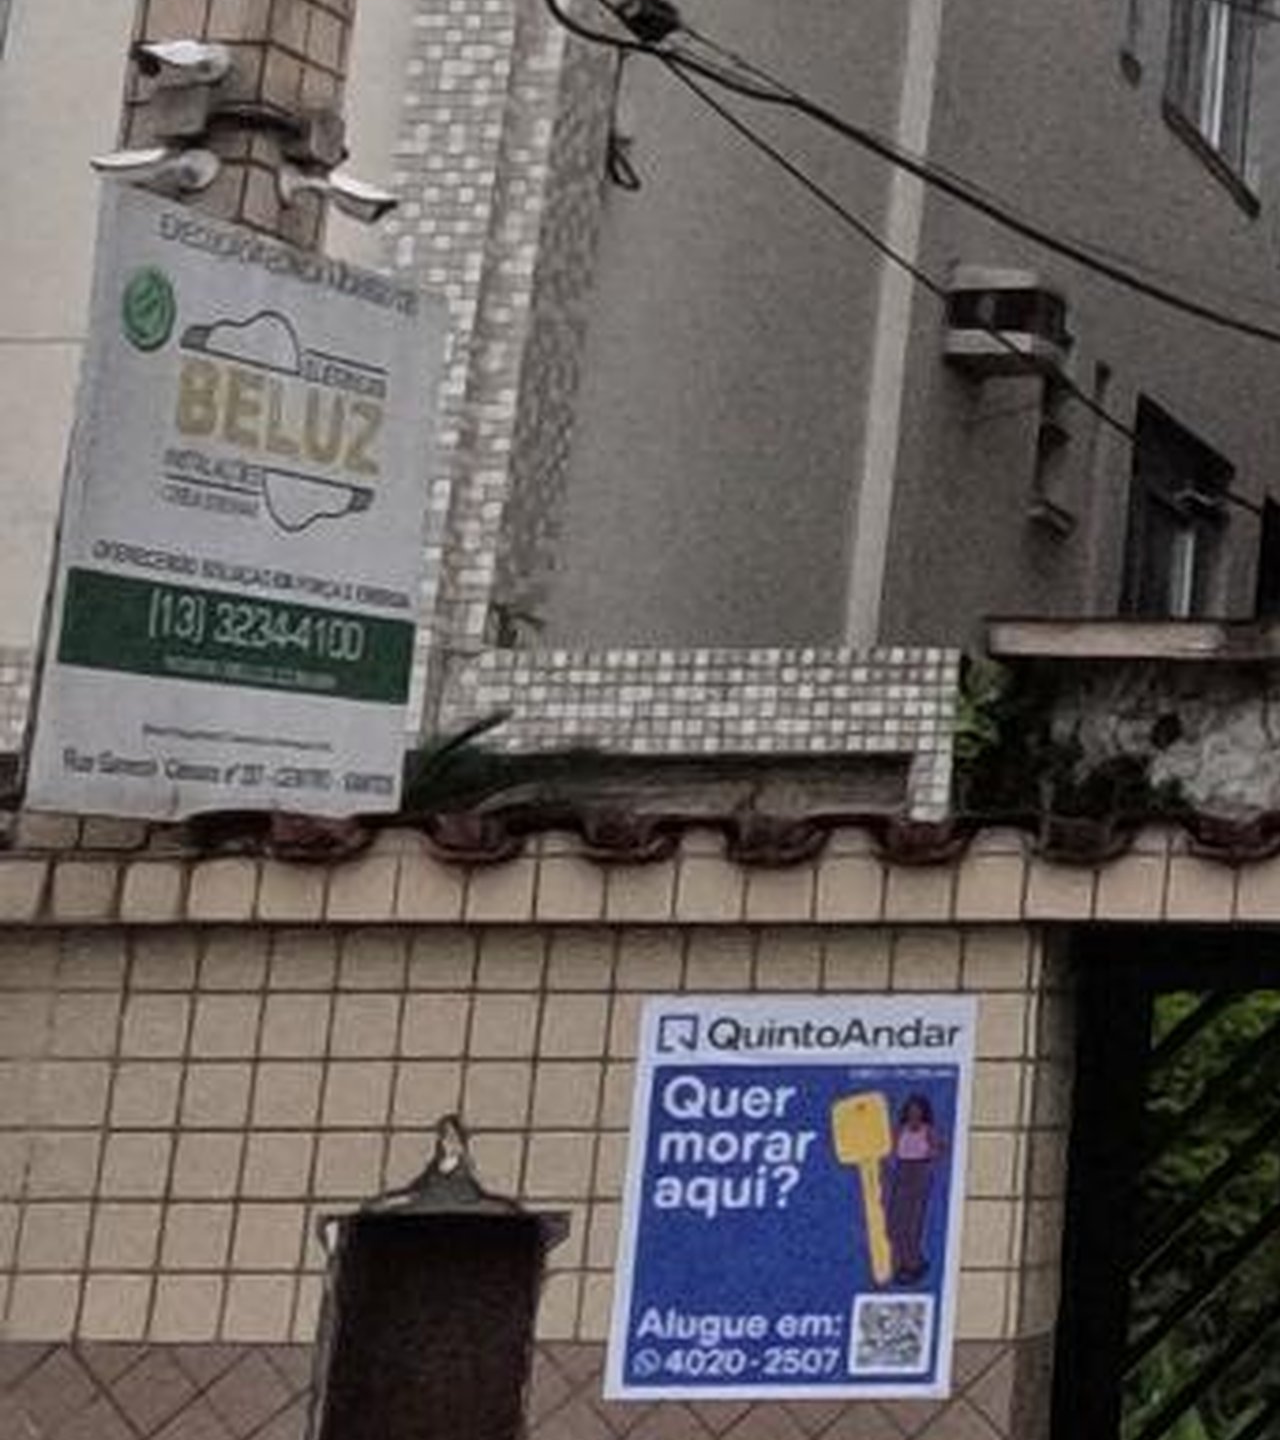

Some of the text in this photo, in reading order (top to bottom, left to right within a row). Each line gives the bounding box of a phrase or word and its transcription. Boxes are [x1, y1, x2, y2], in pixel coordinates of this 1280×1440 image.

[178, 359, 382, 474] BELUZ
[150, 587, 206, 643] (13)
[707, 1018, 961, 1052] QuintoAndar
[663, 1075, 796, 1120] Quer
[658, 1130, 817, 1163] morar
[653, 1165, 800, 1220] aqui?
[635, 1306, 843, 1347] Alugue em:
